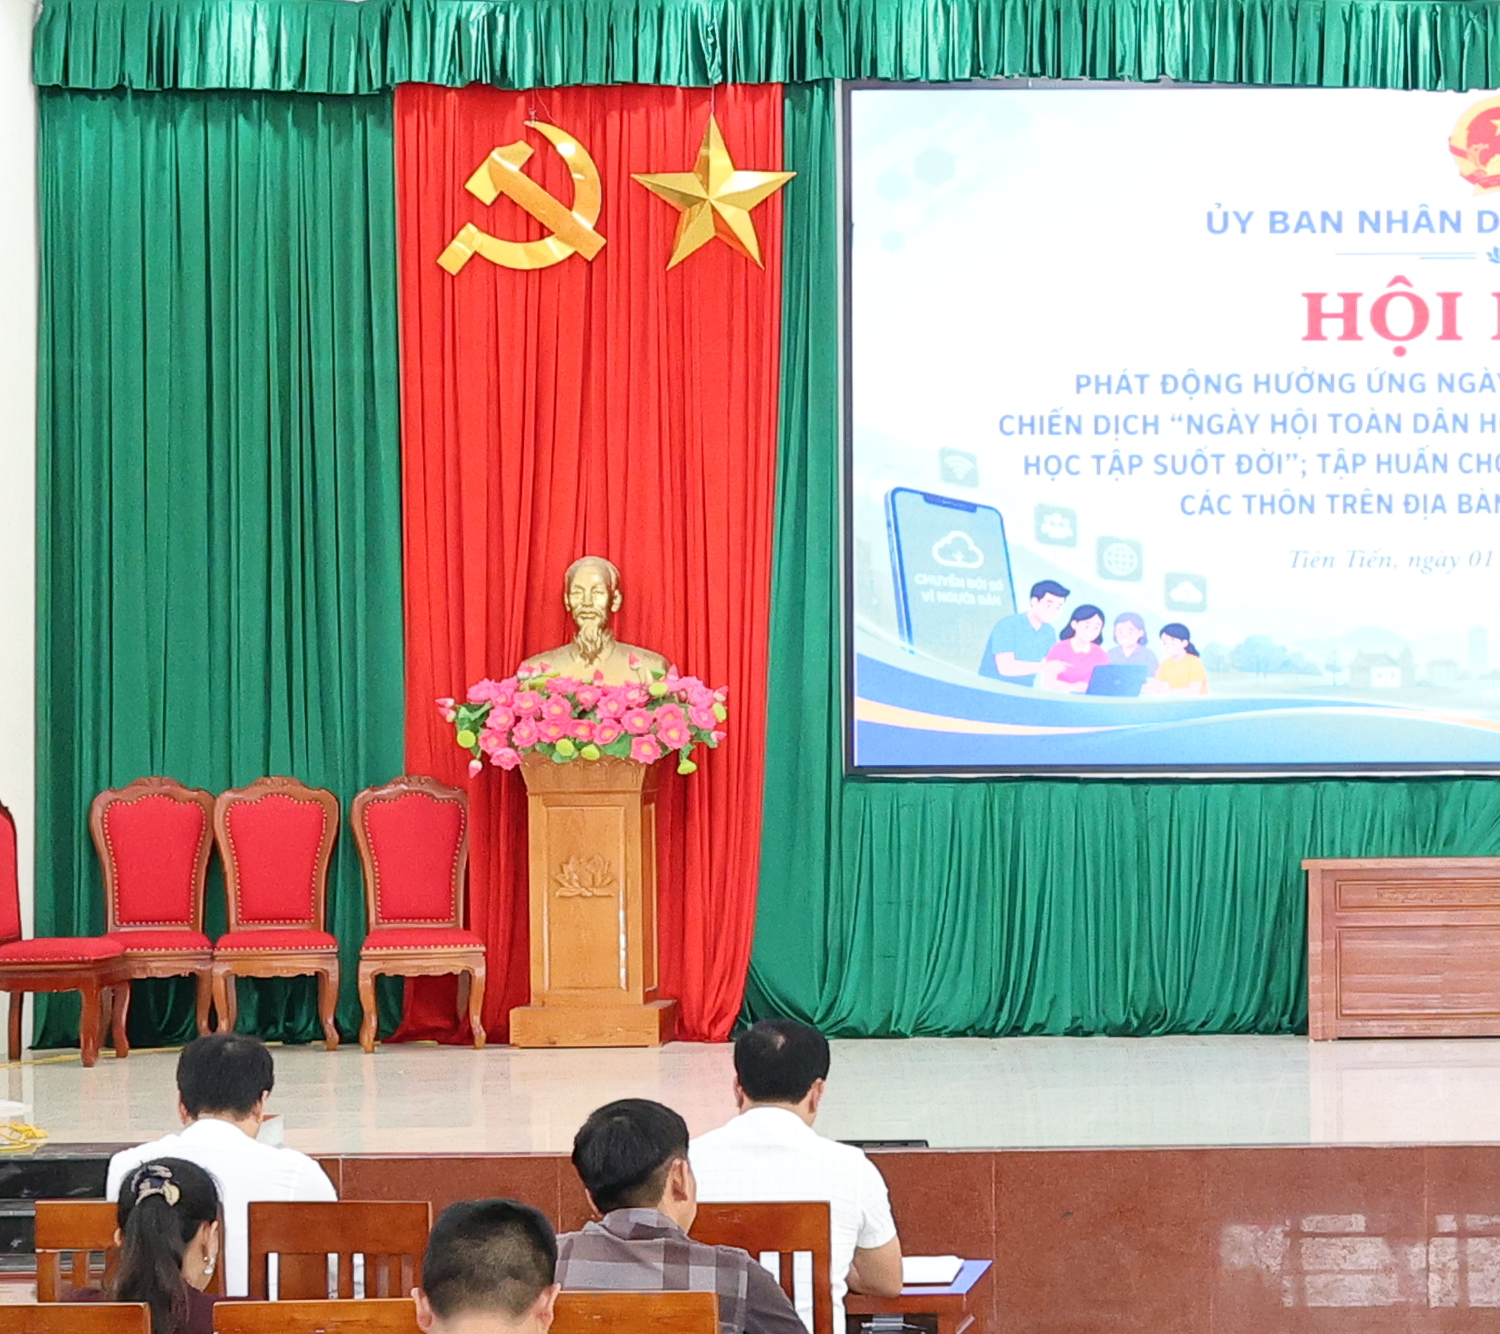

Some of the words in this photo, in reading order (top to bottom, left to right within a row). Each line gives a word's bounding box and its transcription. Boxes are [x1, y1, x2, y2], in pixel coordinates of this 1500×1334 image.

[1207, 203, 1254, 235] ỦY
[1269, 210, 1343, 234] BAN
[1359, 203, 1461, 233] NHÂN
[1302, 276, 1462, 356] HỘI
[1076, 368, 1150, 394] PHÁT
[1160, 368, 1242, 400] ĐỘNG
[1254, 366, 1356, 394] HƯỞNG
[1367, 367, 1426, 393] ỨNG
[999, 407, 1082, 436] CHIẾN
[1094, 414, 1159, 441] DỊCH
[1271, 407, 1317, 440] HỘI
[1327, 407, 1402, 434] TOÀN
[1413, 407, 1468, 434] DÂN
[1024, 454, 1081, 481] HỌC
[1091, 449, 1143, 481] TẬP
[1154, 446, 1226, 475] SUỐT
[1317, 448, 1367, 480] TẬP
[1377, 445, 1448, 474] HUẤN
[1180, 489, 1232, 516] CÁC
[1242, 488, 1315, 515] THÔN
[1325, 488, 1393, 514] TRÊN
[1403, 494, 1447, 520] ĐỊA
[1290, 550, 1335, 568] Tiên
[1409, 549, 1460, 574] ngày
[1469, 550, 1493, 567] 01
